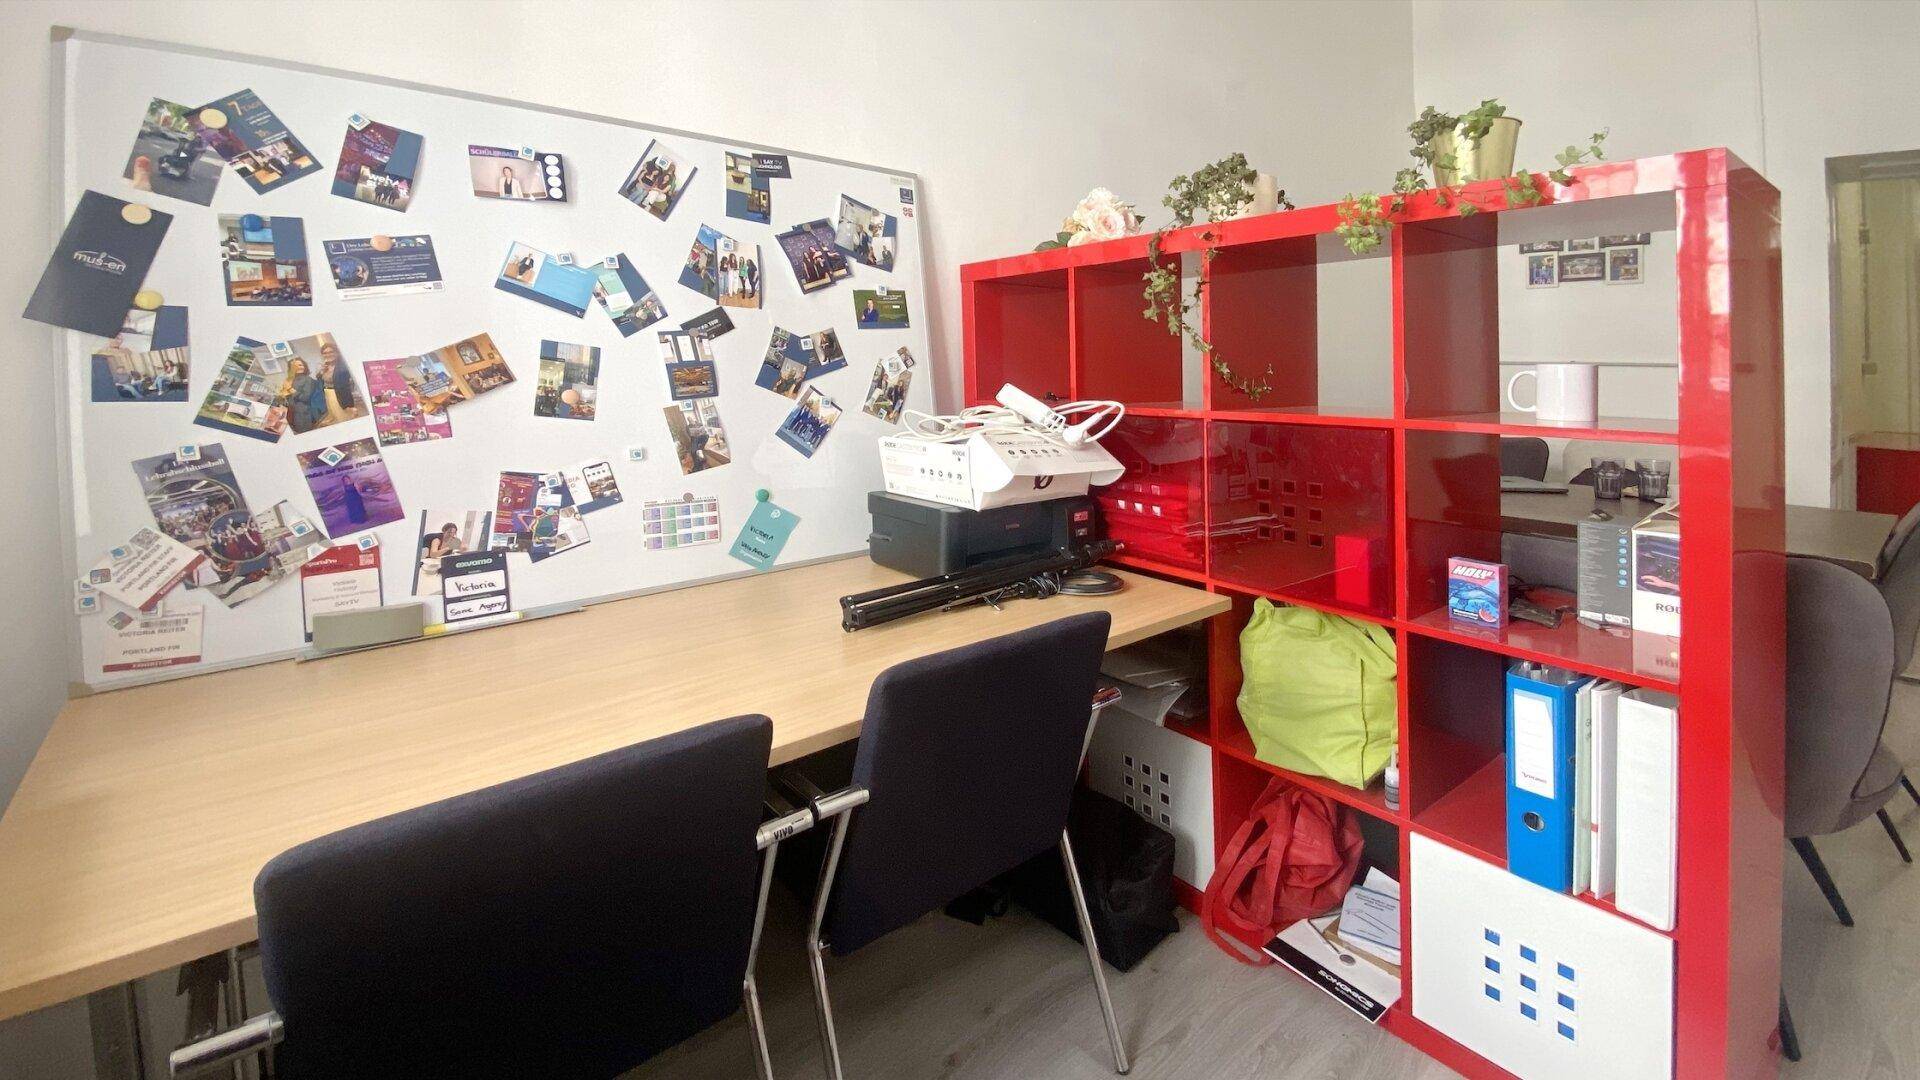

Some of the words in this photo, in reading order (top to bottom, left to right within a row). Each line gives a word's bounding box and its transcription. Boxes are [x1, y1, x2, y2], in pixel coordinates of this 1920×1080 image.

[73, 252, 127, 272] mus-en
[1452, 565, 1495, 580] HOLY
[455, 580, 497, 593] Victoria
[773, 825, 794, 840] VIVO
[1318, 969, 1375, 1008] SONGMICS
